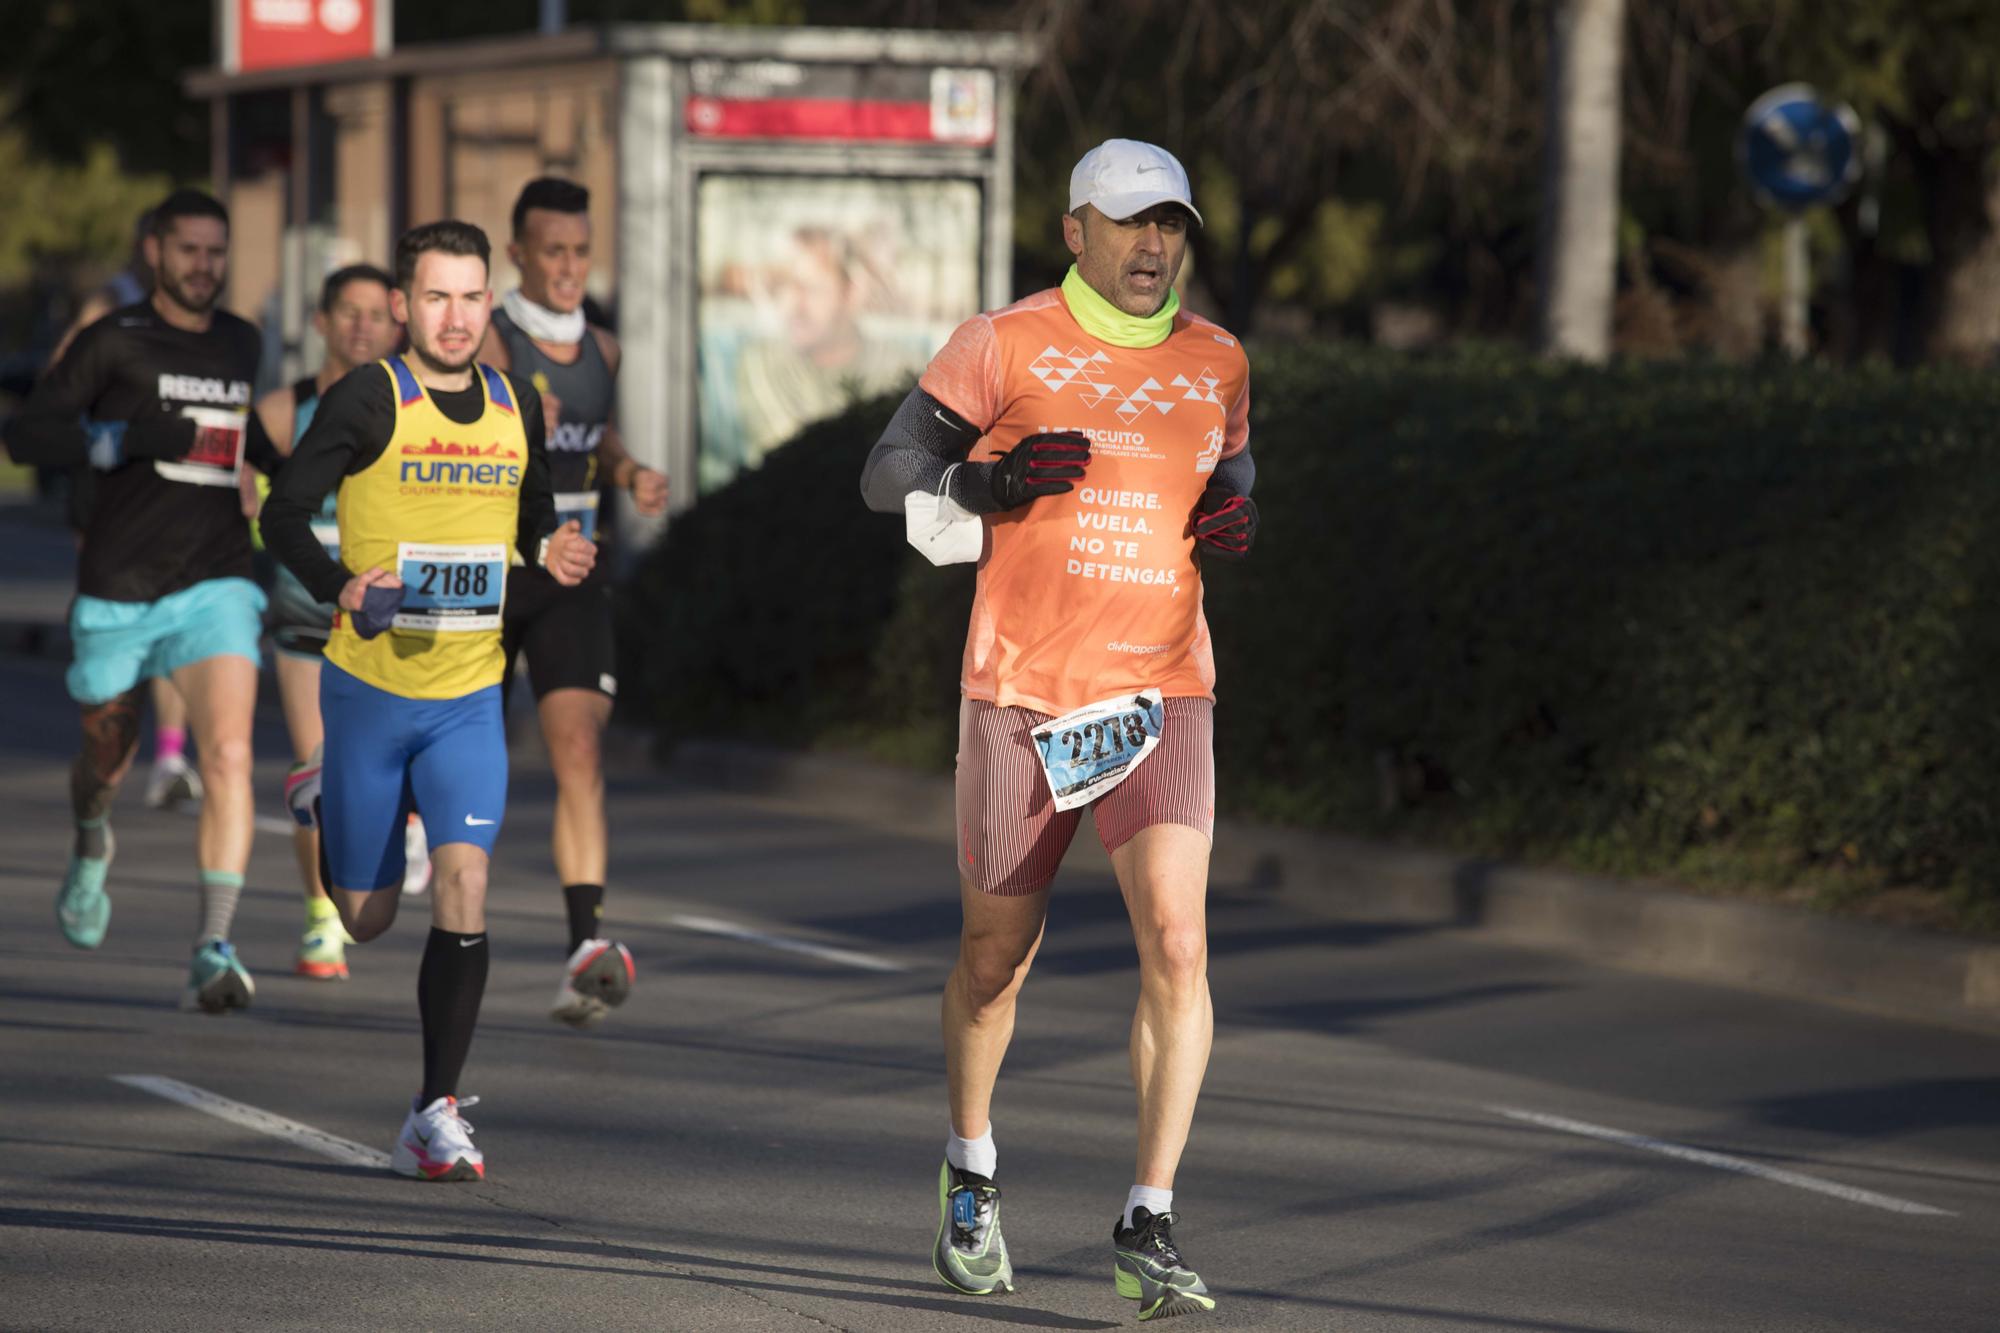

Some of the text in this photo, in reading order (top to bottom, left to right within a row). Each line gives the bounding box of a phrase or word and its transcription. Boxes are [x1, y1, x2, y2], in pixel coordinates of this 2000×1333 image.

[400, 460, 520, 486] runners
[1079, 487, 1162, 510] QUIERE.
[1076, 511, 1153, 535] VUELA.
[1070, 536, 1139, 558] NO TE
[418, 564, 488, 597] 2188
[1061, 713, 1149, 769] 2278
